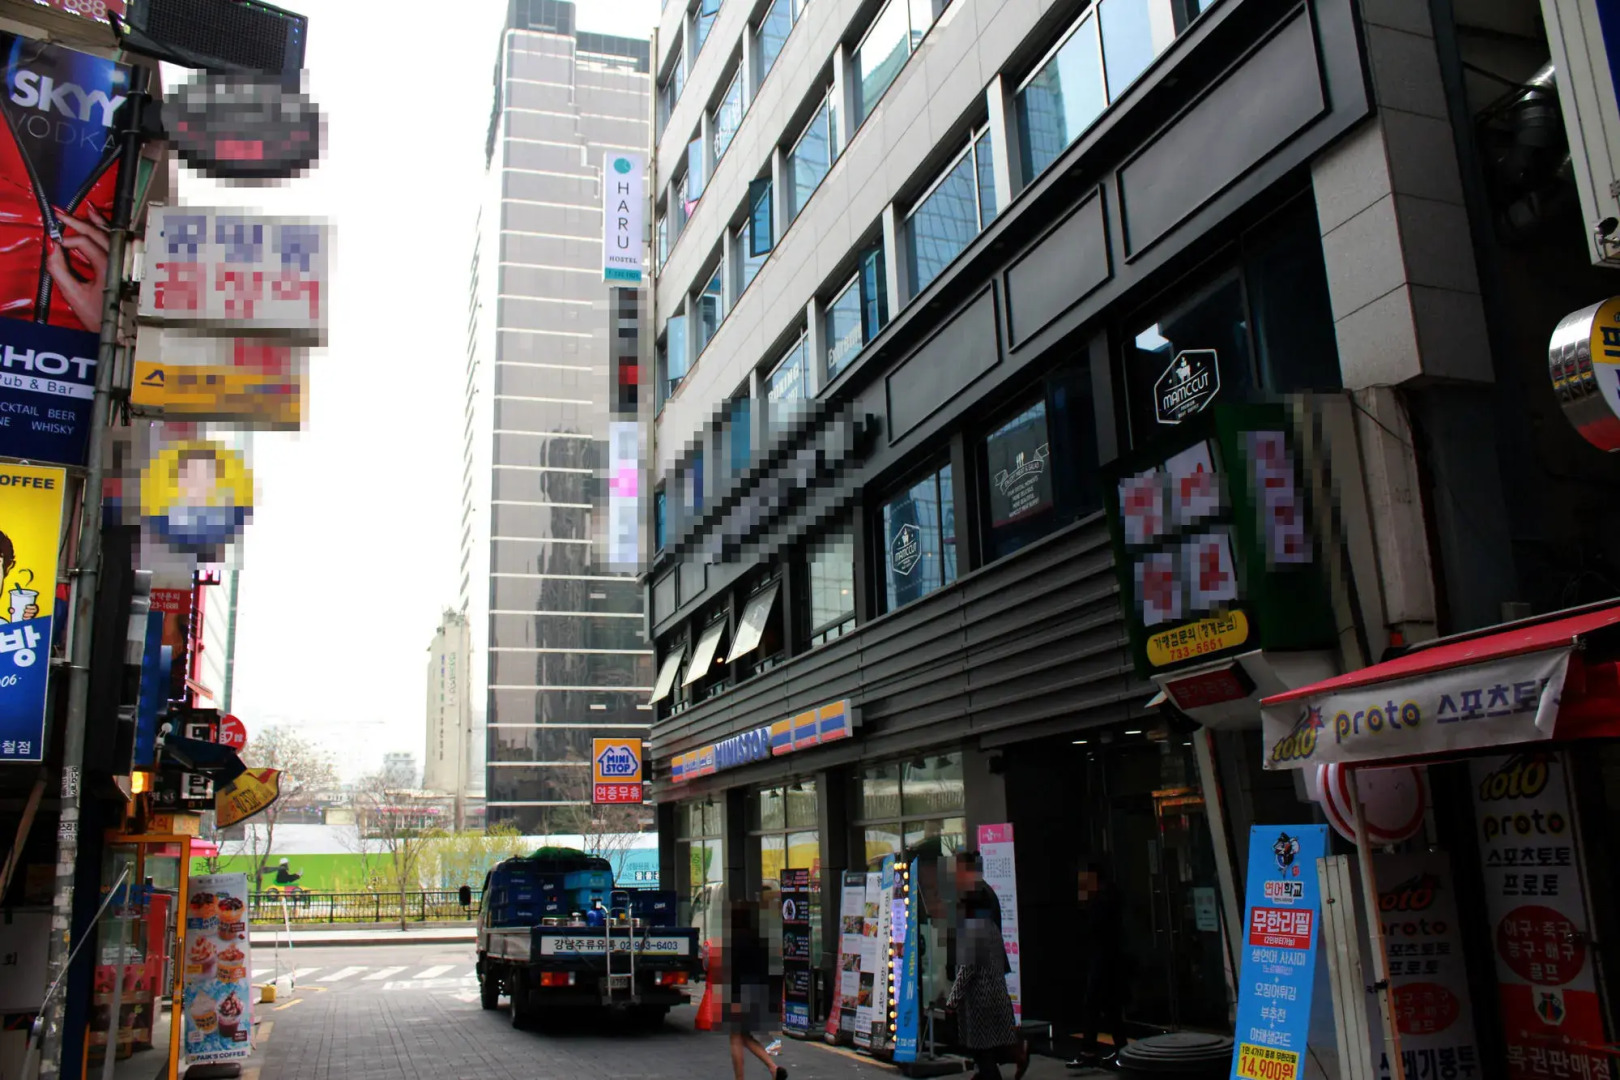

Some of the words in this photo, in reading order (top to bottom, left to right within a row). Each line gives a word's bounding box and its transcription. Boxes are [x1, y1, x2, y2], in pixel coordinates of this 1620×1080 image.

[10, 69, 127, 128] SKYY
[6, 110, 117, 152] VODKA
[617, 181, 630, 249] HARU
[609, 255, 638, 264] HOSTEL
[0, 344, 98, 379] HOT
[29, 379, 39, 390] &
[47, 381, 74, 394] Bar
[47, 408, 76, 421] BEER
[31, 421, 74, 435] WHISKY
[1153, 627, 1195, 651] 가맹점문의
[1335, 700, 1421, 743] proto
[0, 740, 31, 756] 철점
[715, 727, 770, 769] MINISTOP
[605, 763, 631, 774] STOP
[606, 754, 630, 765] MINI
[596, 786, 640, 800] 연중무휴
[1483, 809, 1565, 842] proto
[1486, 847, 1571, 867] 스포츠토토
[1265, 882, 1303, 897] 연어학교
[1503, 874, 1559, 896] 프로토
[1379, 888, 1434, 912] oto
[1253, 910, 1310, 935] 무한리필
[1382, 918, 1447, 936] roto
[1252, 948, 1278, 963] 생연어
[1280, 951, 1306, 966] 사시미
[1389, 942, 1451, 956] 포츠토토
[1530, 962, 1560, 981] 골프
[1254, 982, 1297, 1001] 오징어튀김
[1260, 1006, 1287, 1022] 부추전
[1250, 1027, 1292, 1047] 야채샐러드
[219, 1050, 246, 1058] COFFEE
[1506, 1044, 1612, 1080] 복권판매점
[1241, 1056, 1294, 1080] 14,900원
